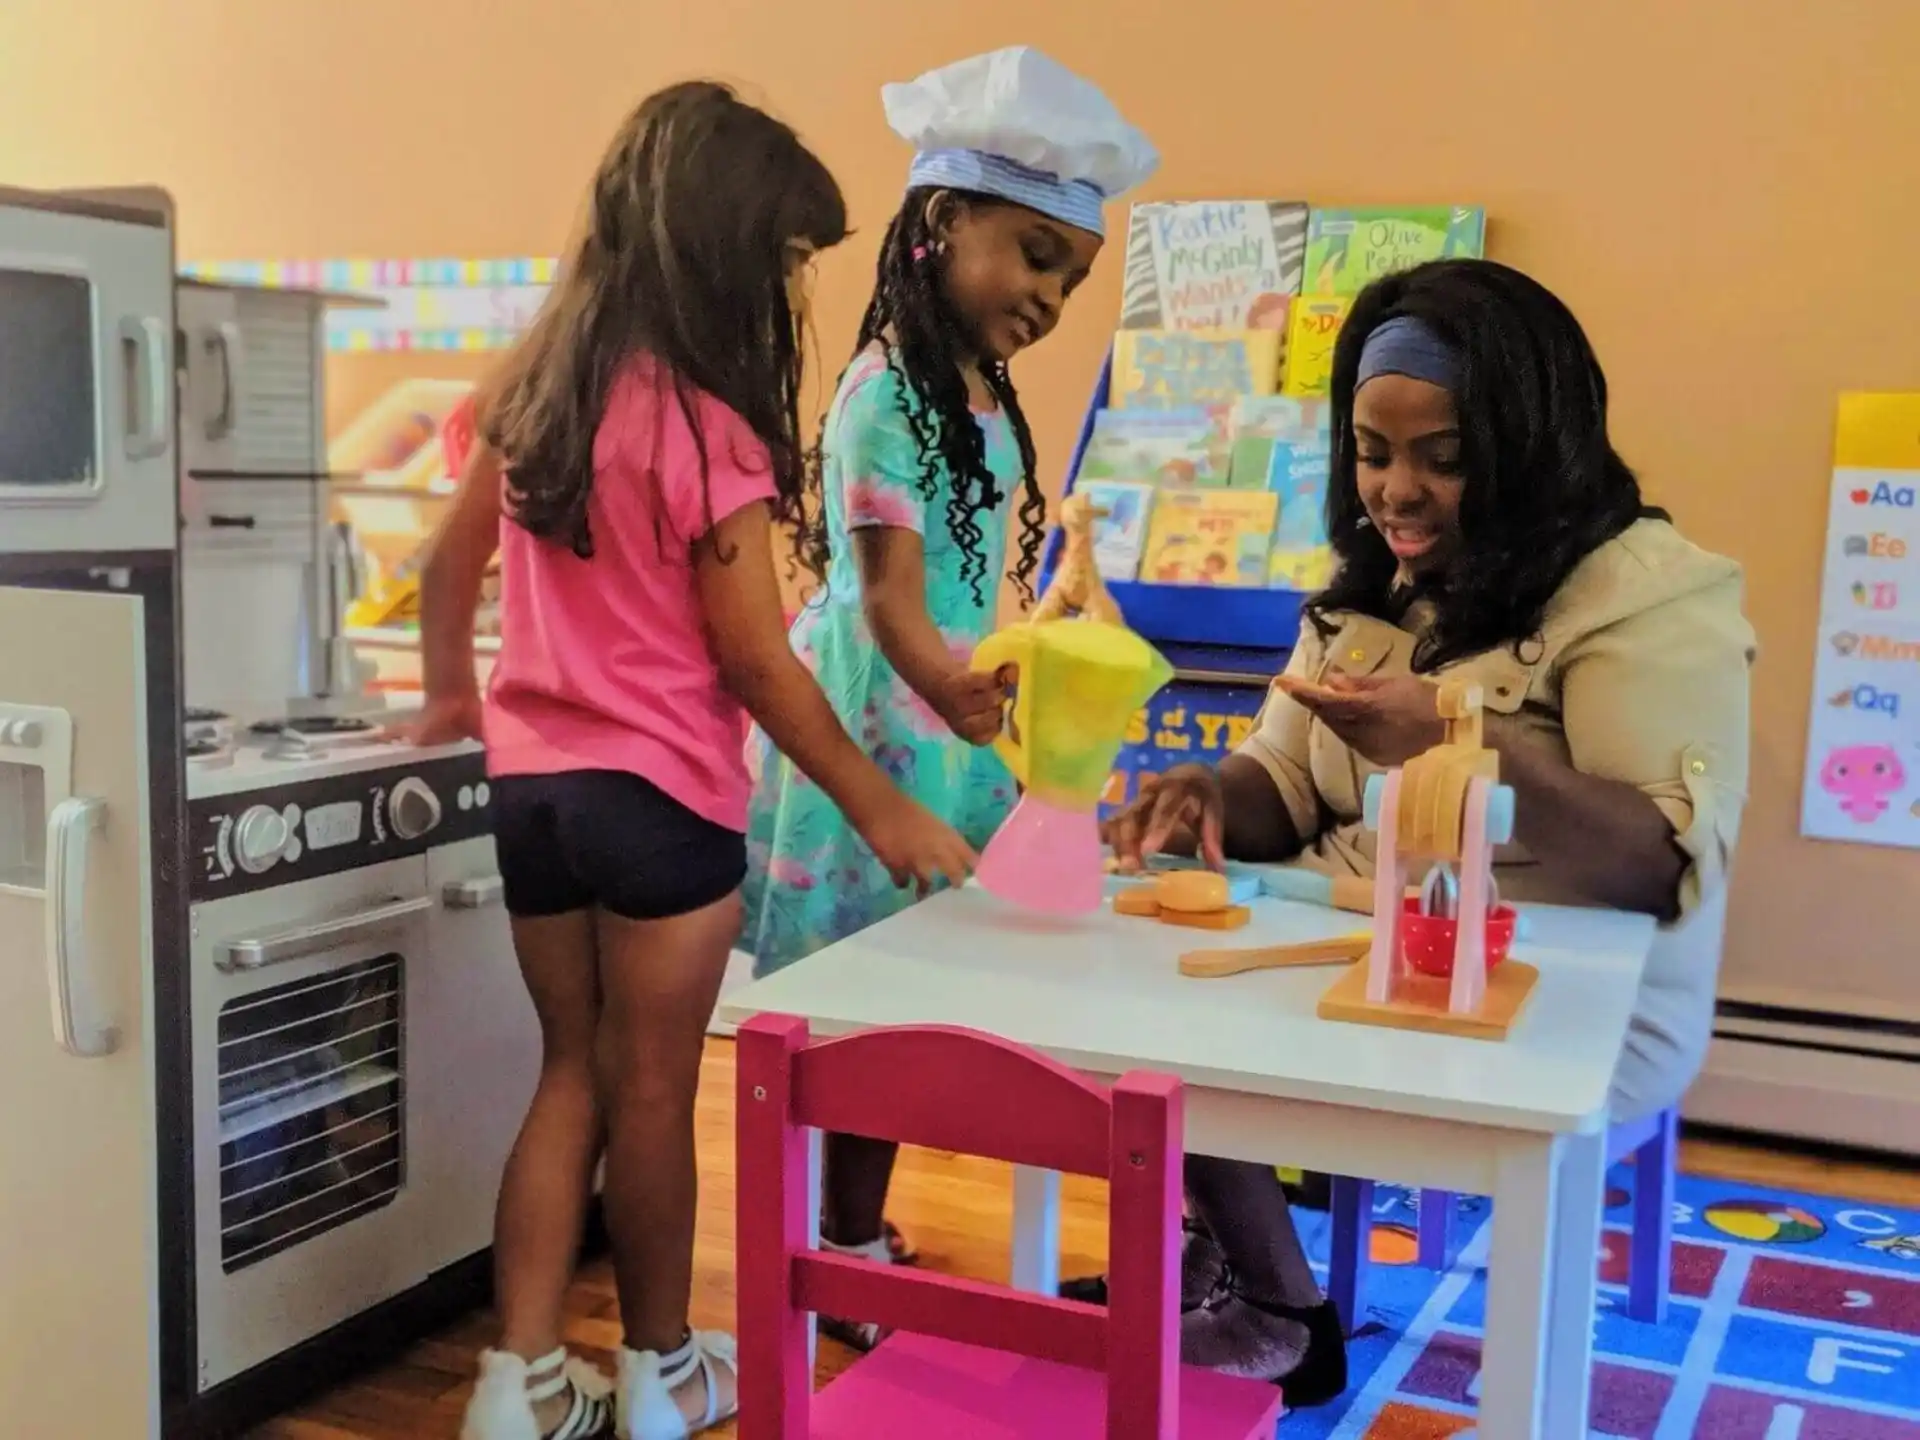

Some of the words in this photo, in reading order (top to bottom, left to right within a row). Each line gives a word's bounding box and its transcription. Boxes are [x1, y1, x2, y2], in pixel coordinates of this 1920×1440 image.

[1157, 204, 1247, 250] Katie
[1369, 222, 1424, 248] Olive
[1871, 480, 1914, 508] Aa
[1869, 532, 1907, 558] Ee
[1854, 683, 1899, 718] Qq
[1805, 1337, 1906, 1384] F
